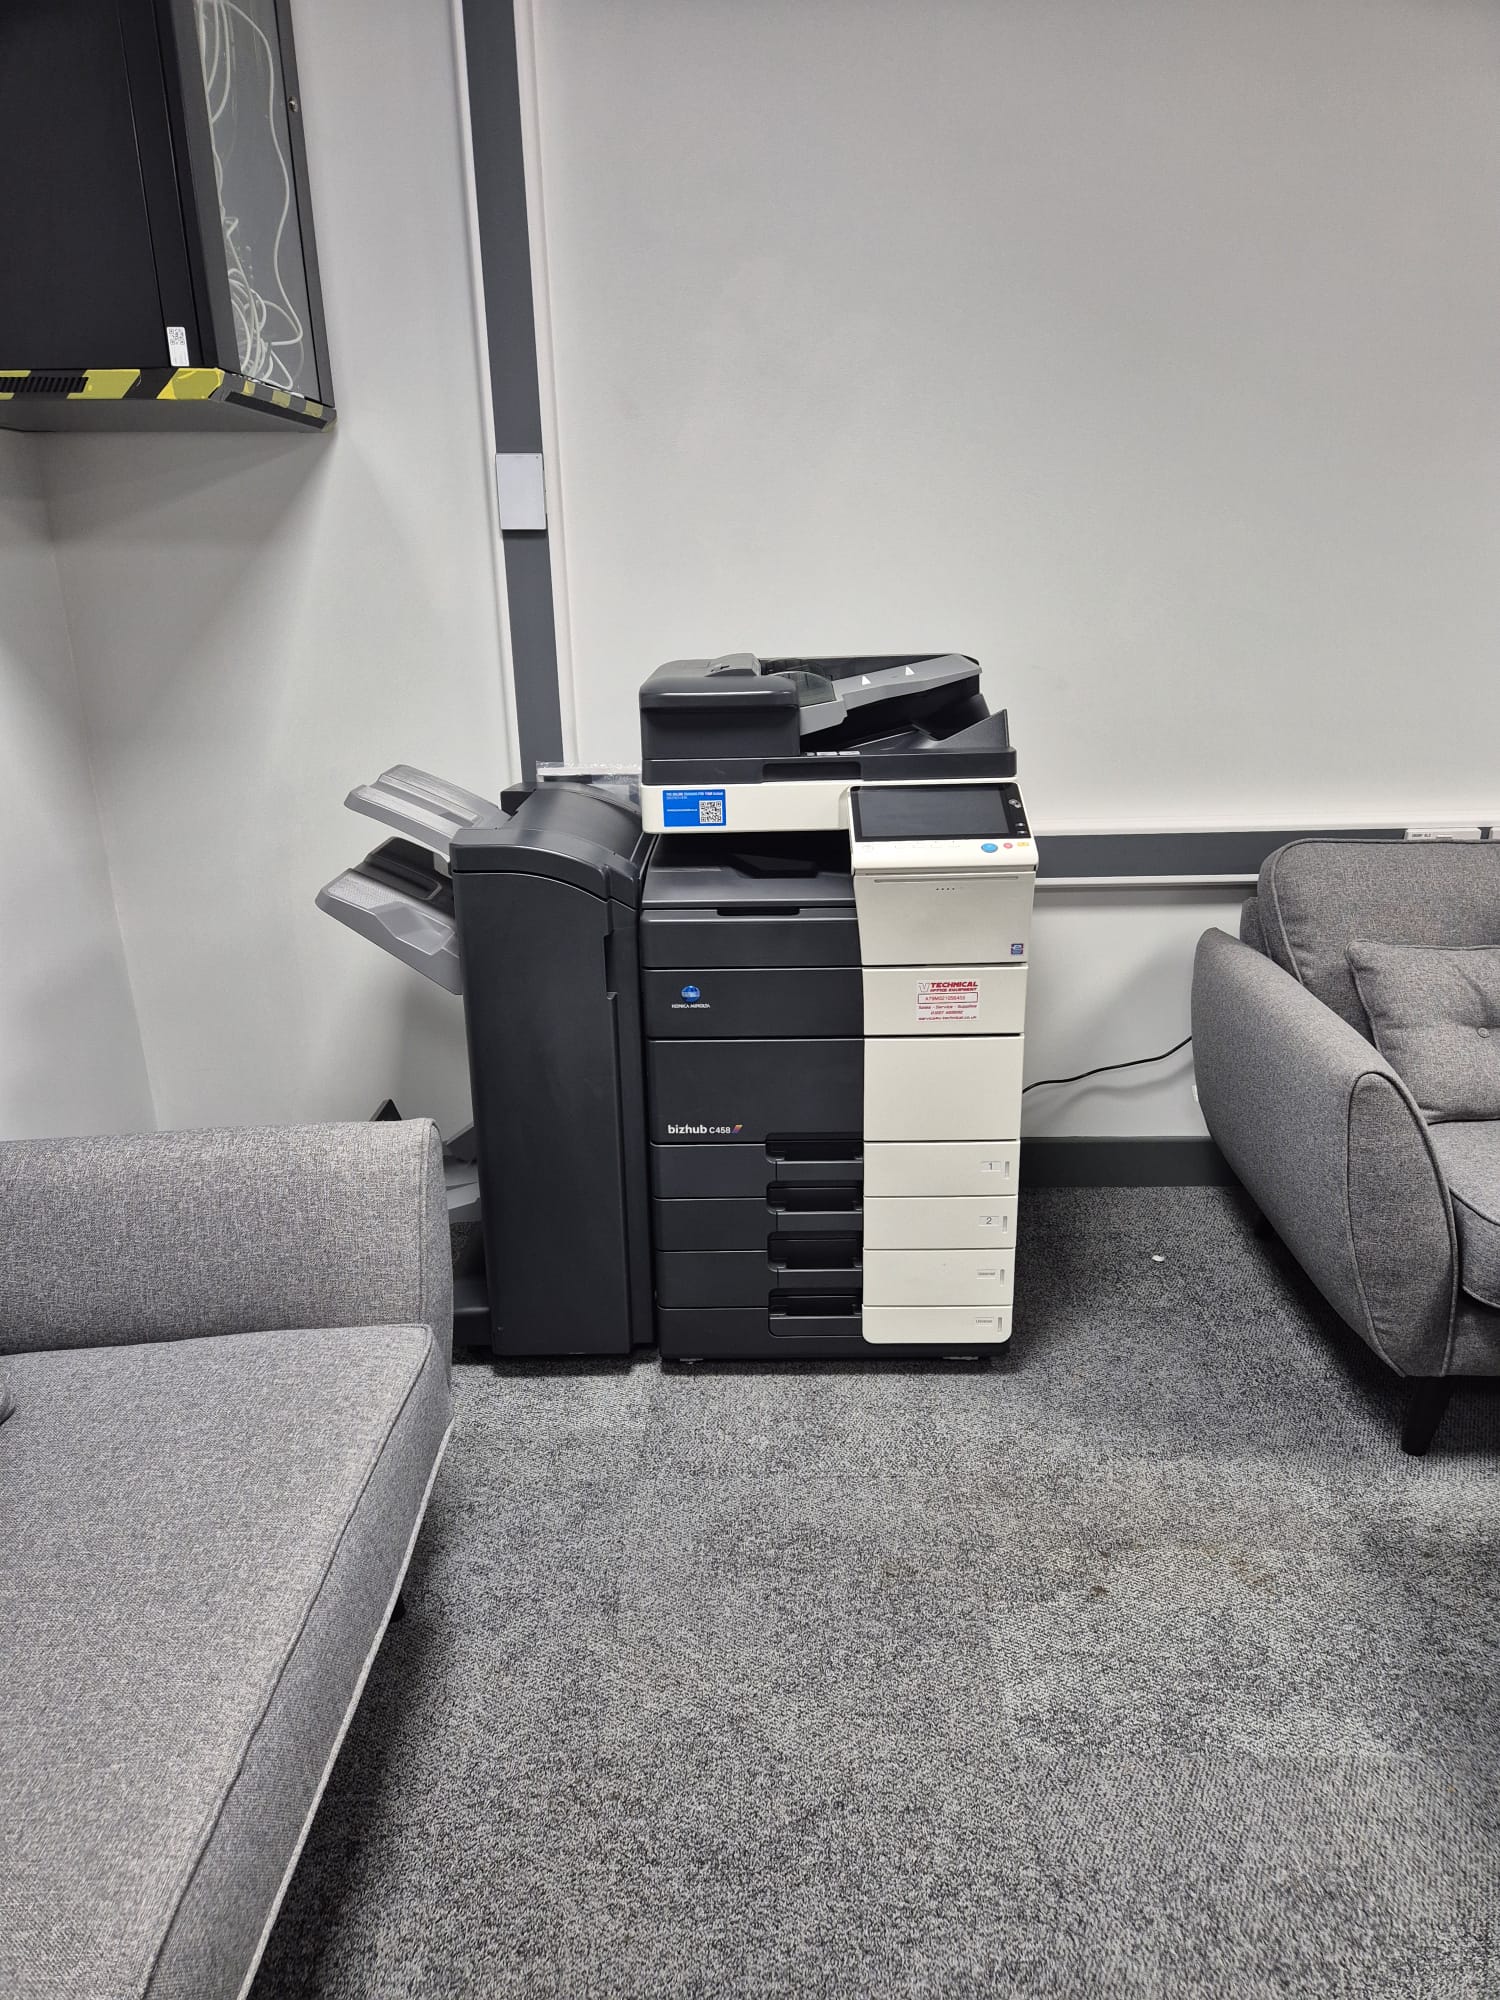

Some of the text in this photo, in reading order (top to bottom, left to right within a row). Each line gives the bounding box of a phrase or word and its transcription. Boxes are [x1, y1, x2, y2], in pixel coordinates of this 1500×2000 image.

[667, 1124, 731, 1134] bizhub C458
[985, 1216, 993, 1225] 2
